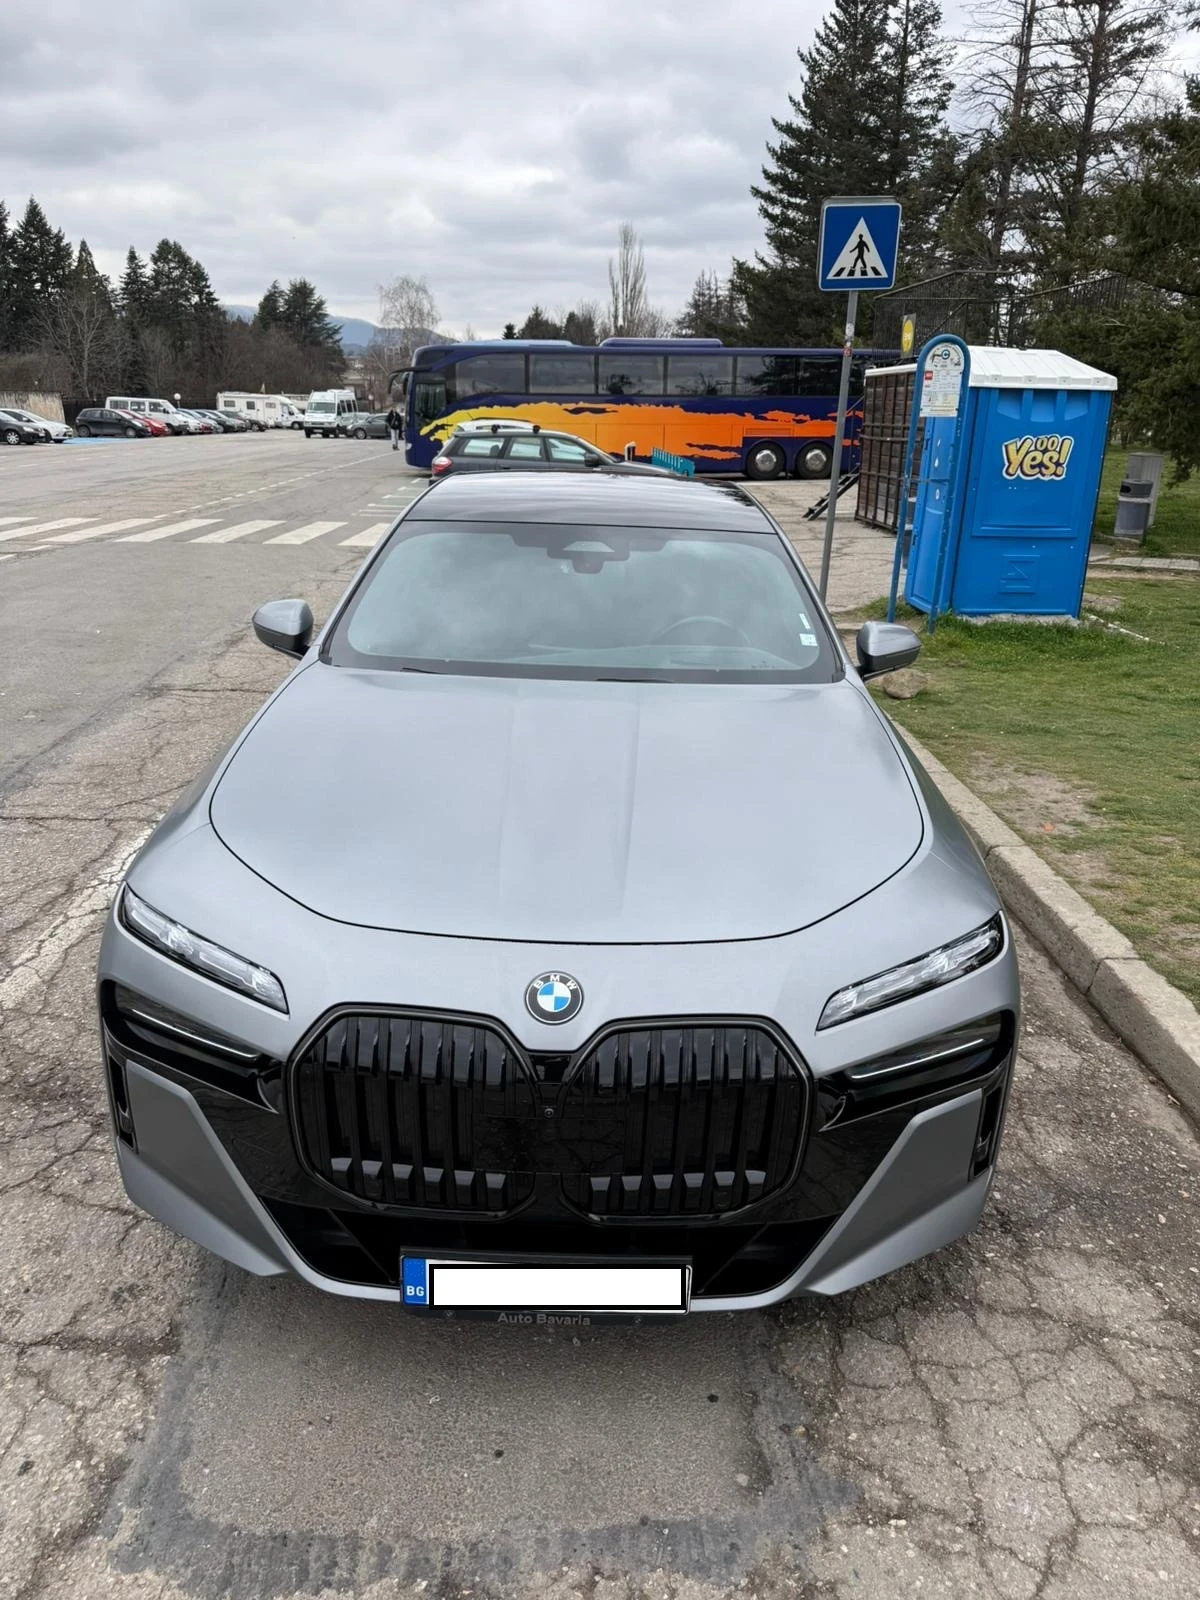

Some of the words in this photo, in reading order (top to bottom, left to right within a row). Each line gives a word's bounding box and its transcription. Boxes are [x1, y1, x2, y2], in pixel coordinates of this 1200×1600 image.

[1005, 437, 1072, 476] Yes!
[533, 974, 577, 990] BMW
[406, 1285, 425, 1297] BG
[497, 1312, 533, 1325] Auto
[536, 1312, 591, 1326] Bavaria
